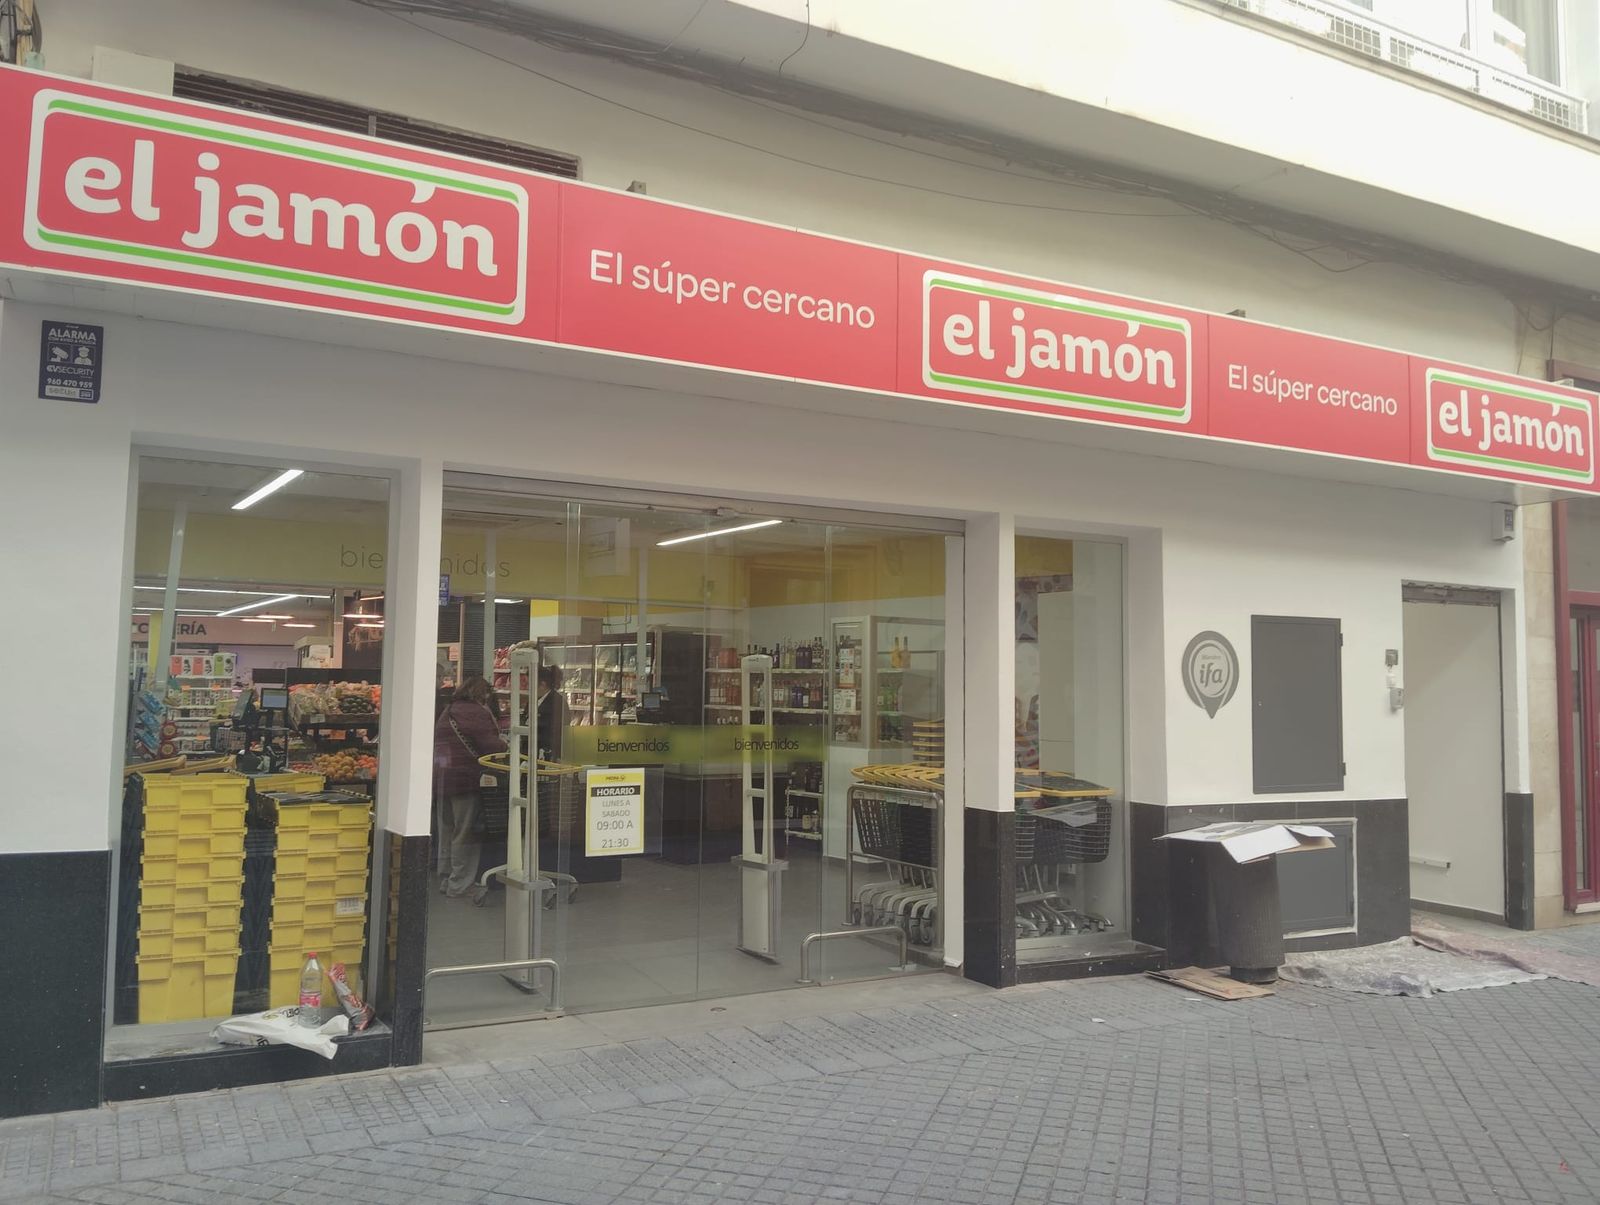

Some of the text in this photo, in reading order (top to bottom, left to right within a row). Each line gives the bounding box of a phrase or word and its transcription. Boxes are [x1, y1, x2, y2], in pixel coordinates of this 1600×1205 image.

[64, 139, 498, 277] el jamón
[589, 248, 876, 329] El súper cercano
[48, 328, 96, 341] ALARMA
[943, 300, 1176, 389] el jamón
[47, 378, 62, 386] 960
[1228, 364, 1398, 416] El súper cercano
[1438, 390, 1585, 457] el jamón
[1199, 662, 1223, 688] ifa
[597, 738, 670, 753] bienvenidos
[734, 736, 799, 751] bienvenidos
[596, 787, 635, 796] HORARIO
[596, 819, 633, 831] 09:00 A
[602, 838, 629, 849] 21:30
